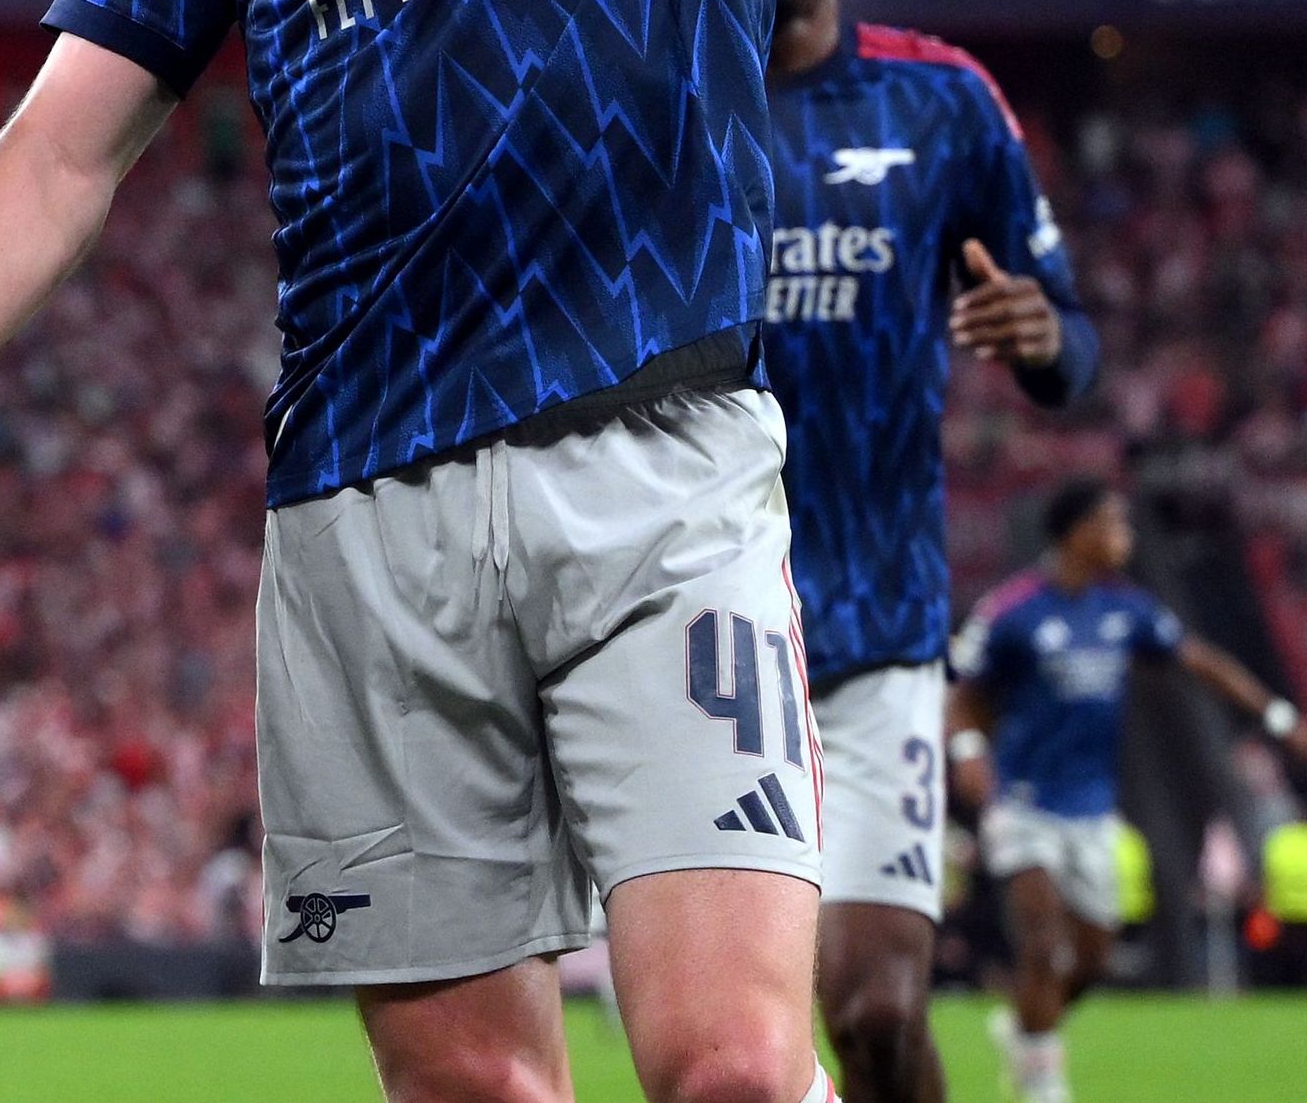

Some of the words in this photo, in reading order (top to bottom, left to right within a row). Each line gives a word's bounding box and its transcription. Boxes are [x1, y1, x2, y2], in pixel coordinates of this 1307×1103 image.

[769, 220, 895, 273] rates
[765, 274, 859, 323] ETTER
[685, 607, 805, 771] 41
